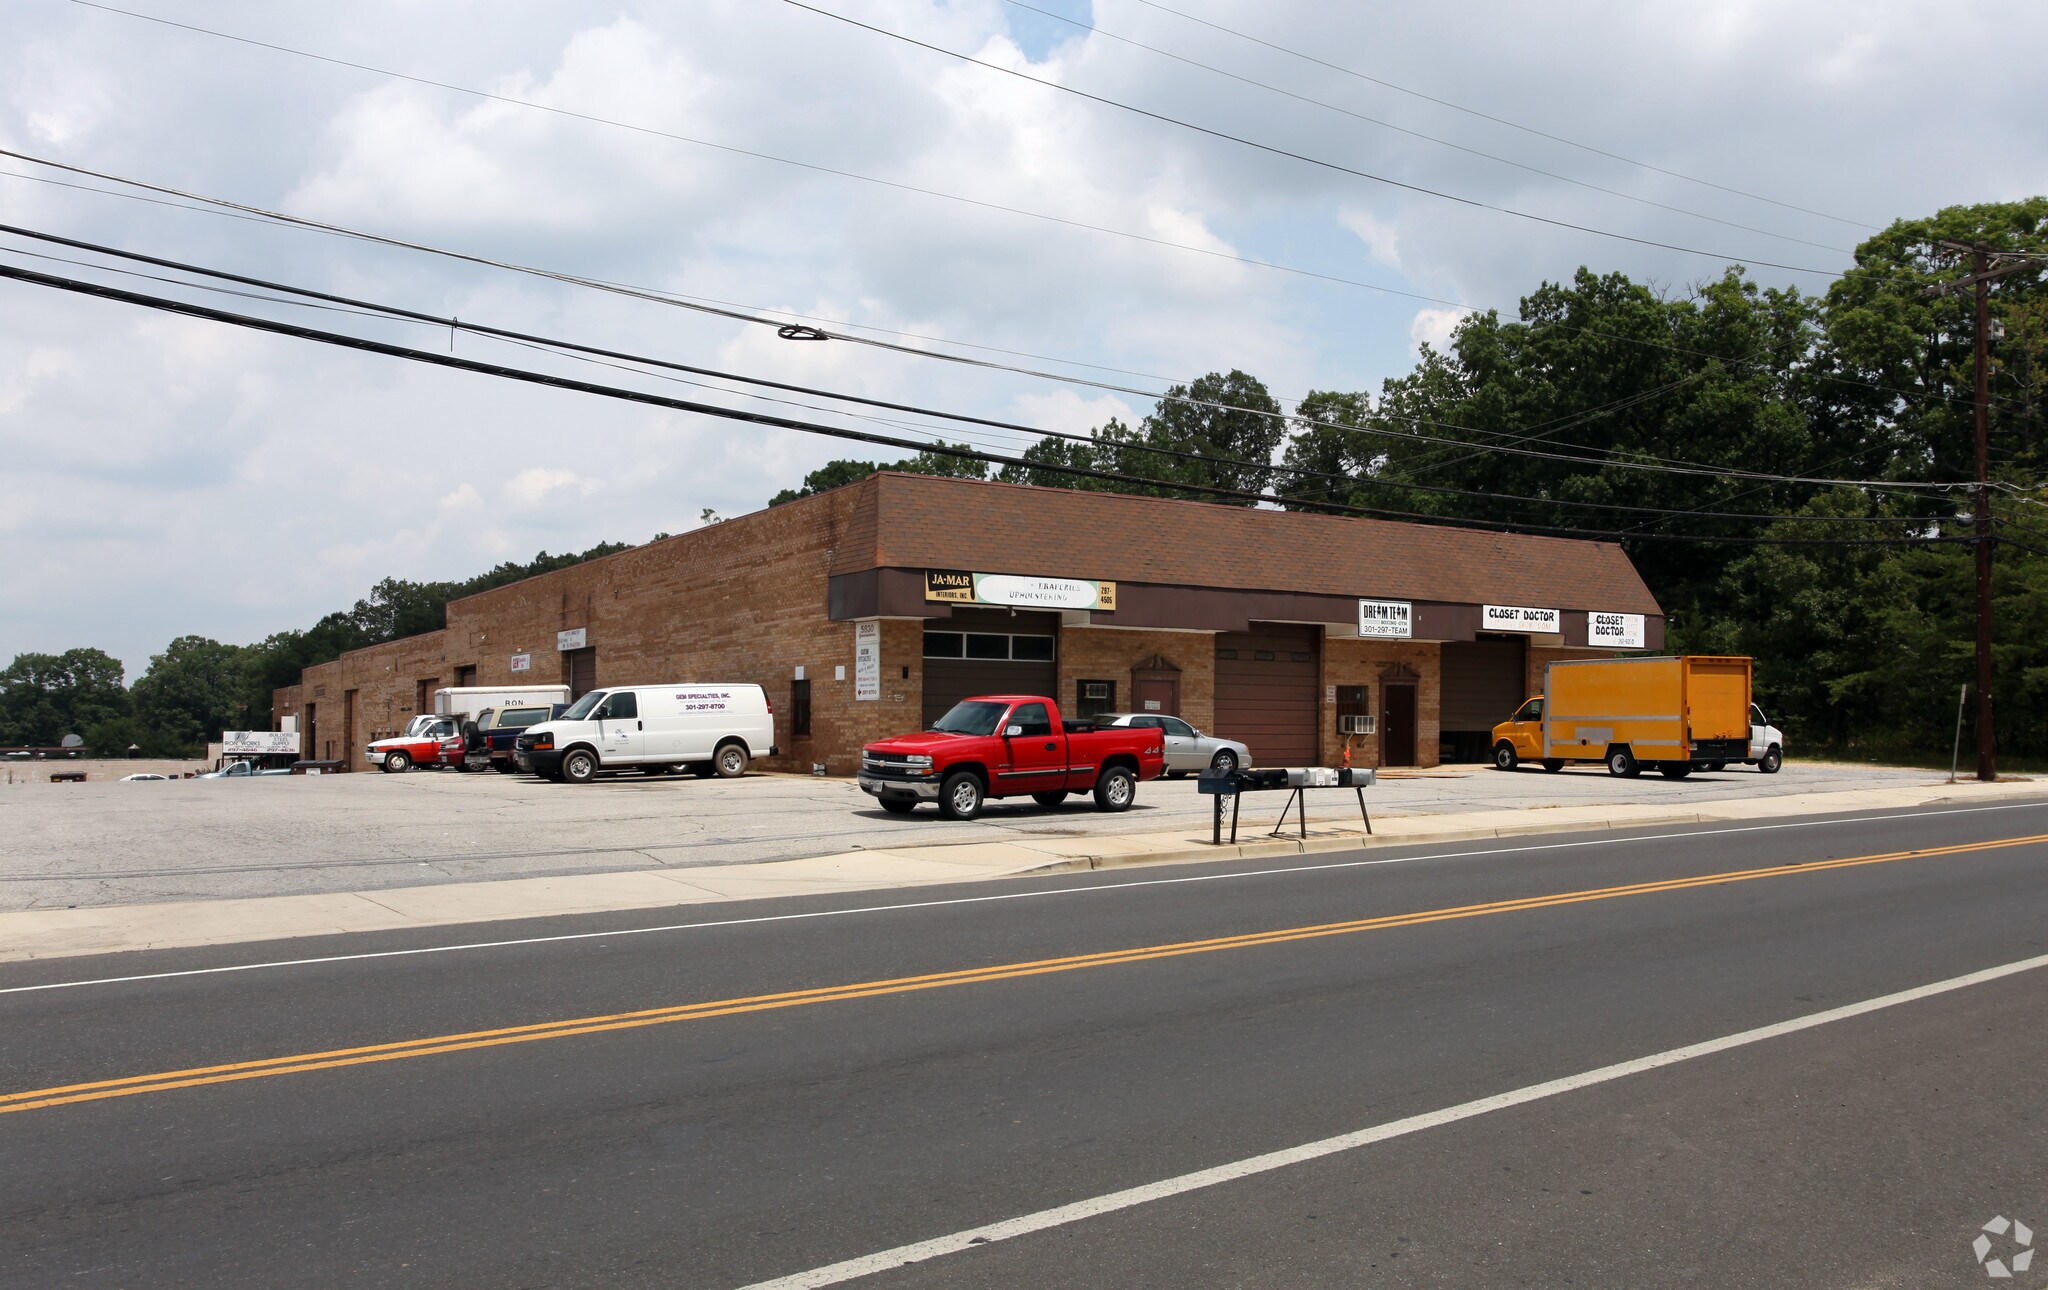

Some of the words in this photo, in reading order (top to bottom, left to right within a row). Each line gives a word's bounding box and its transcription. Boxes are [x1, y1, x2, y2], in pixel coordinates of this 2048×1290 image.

[1364, 604, 1388, 620] DREAM
[1389, 605, 1408, 620] TEAM
[1489, 608, 1520, 620] CLOSET
[1523, 610, 1555, 622] DOCTOR
[1596, 615, 1624, 626] CLOSET
[1364, 626, 1408, 635] 301-297-TEAM
[1596, 625, 1625, 636] DOCTOR
